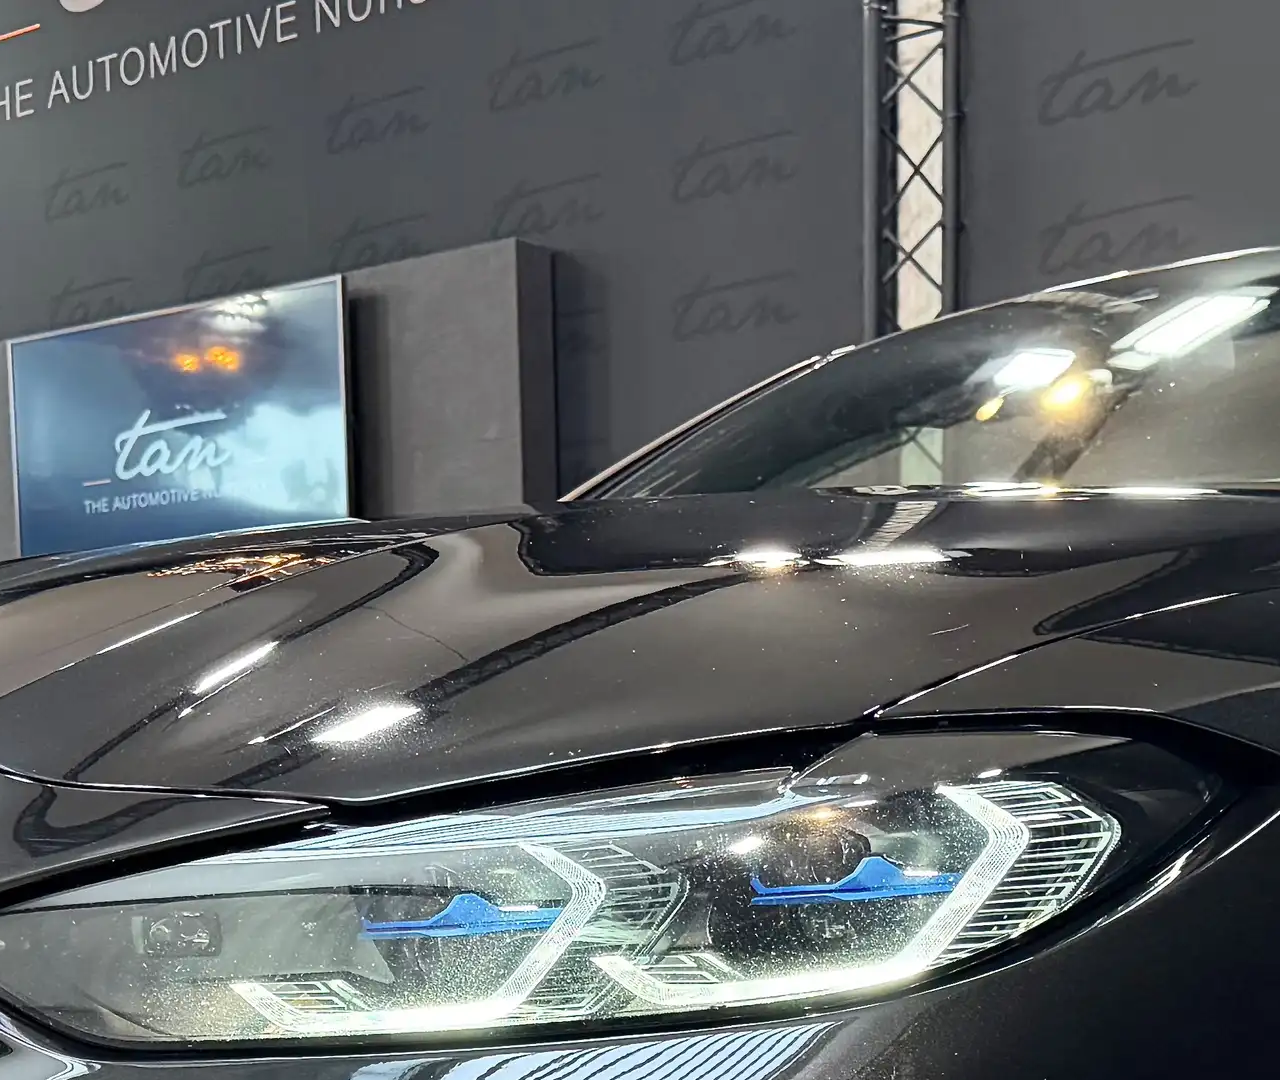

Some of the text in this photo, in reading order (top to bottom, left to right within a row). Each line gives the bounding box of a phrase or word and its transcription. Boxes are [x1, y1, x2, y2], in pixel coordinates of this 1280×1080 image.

[47, 0, 299, 109] AUTOMOTIVE
[115, 409, 232, 481] tan
[84, 498, 109, 514] THE
[112, 487, 199, 511] AUTOMOTIVE
